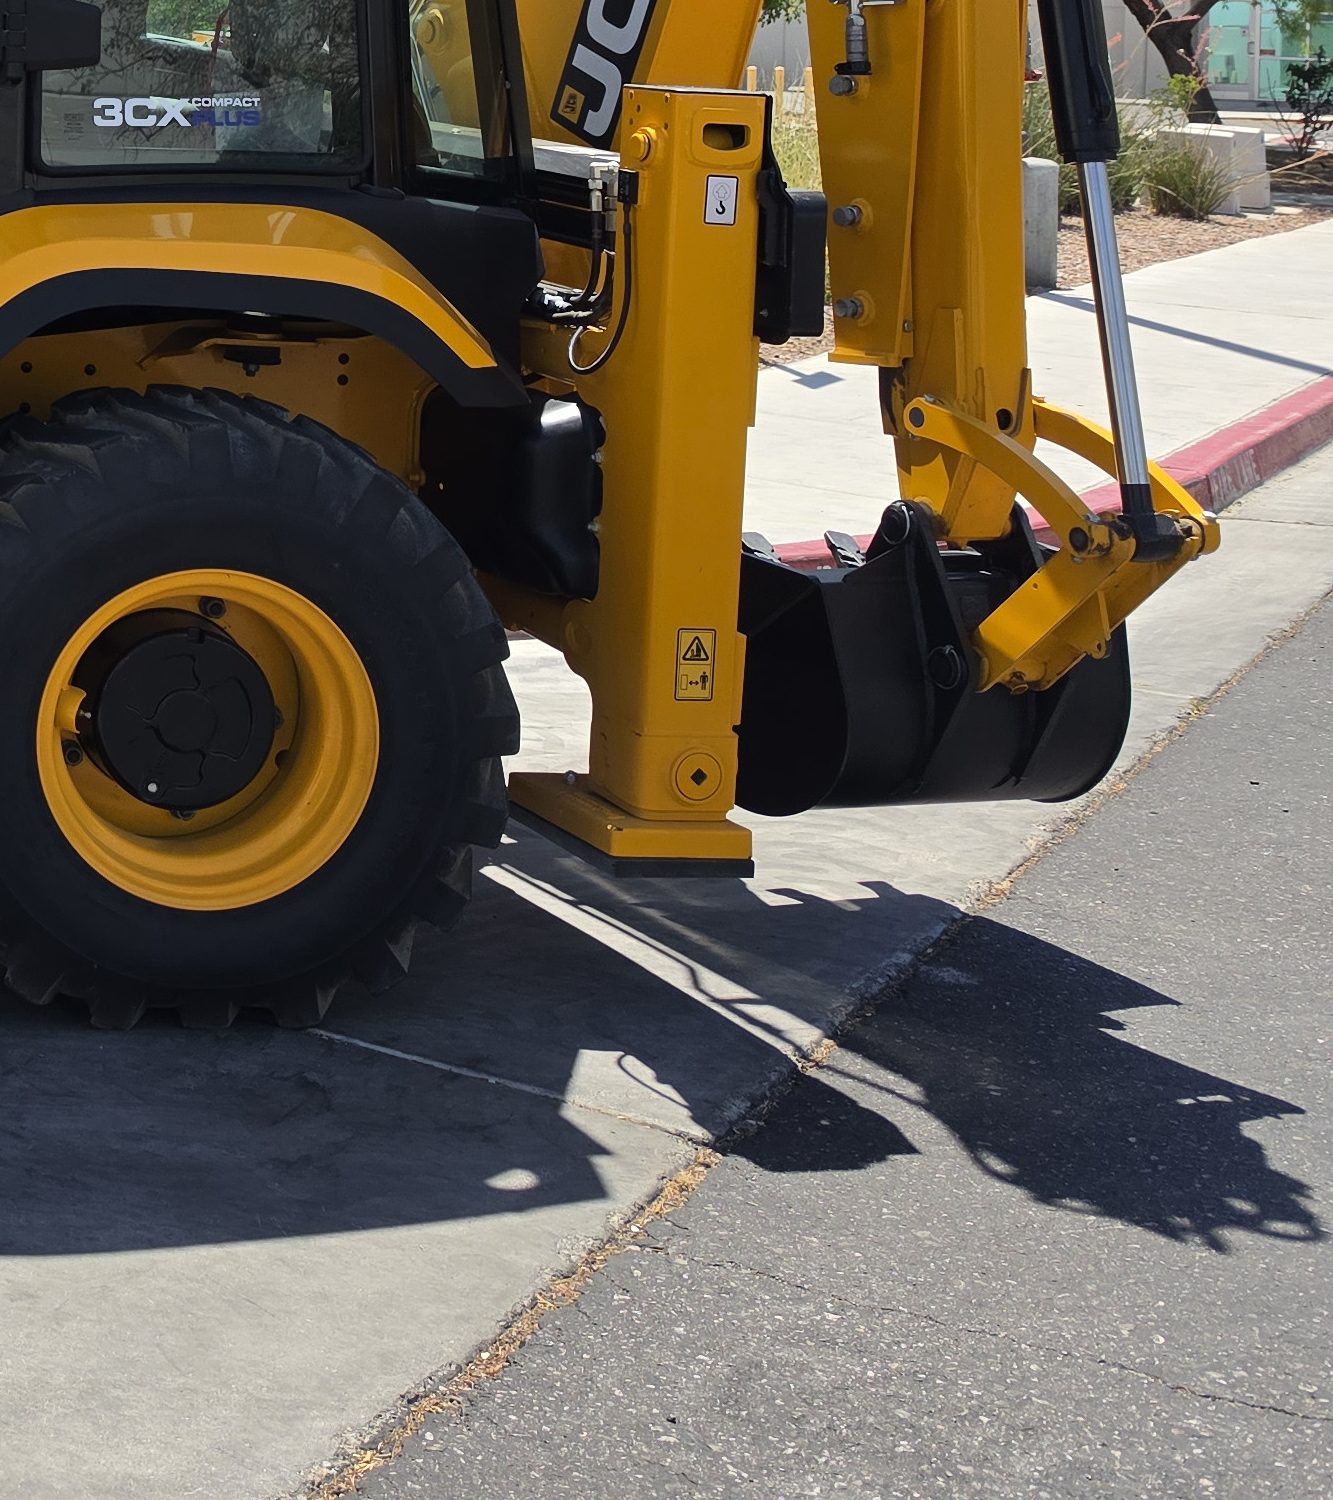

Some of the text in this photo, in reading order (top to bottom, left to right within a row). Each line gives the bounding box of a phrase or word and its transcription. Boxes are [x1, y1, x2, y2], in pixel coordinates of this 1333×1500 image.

[190, 97, 261, 108] COMPACT
[93, 97, 192, 128] 3CX
[191, 110, 261, 127] PLUS
